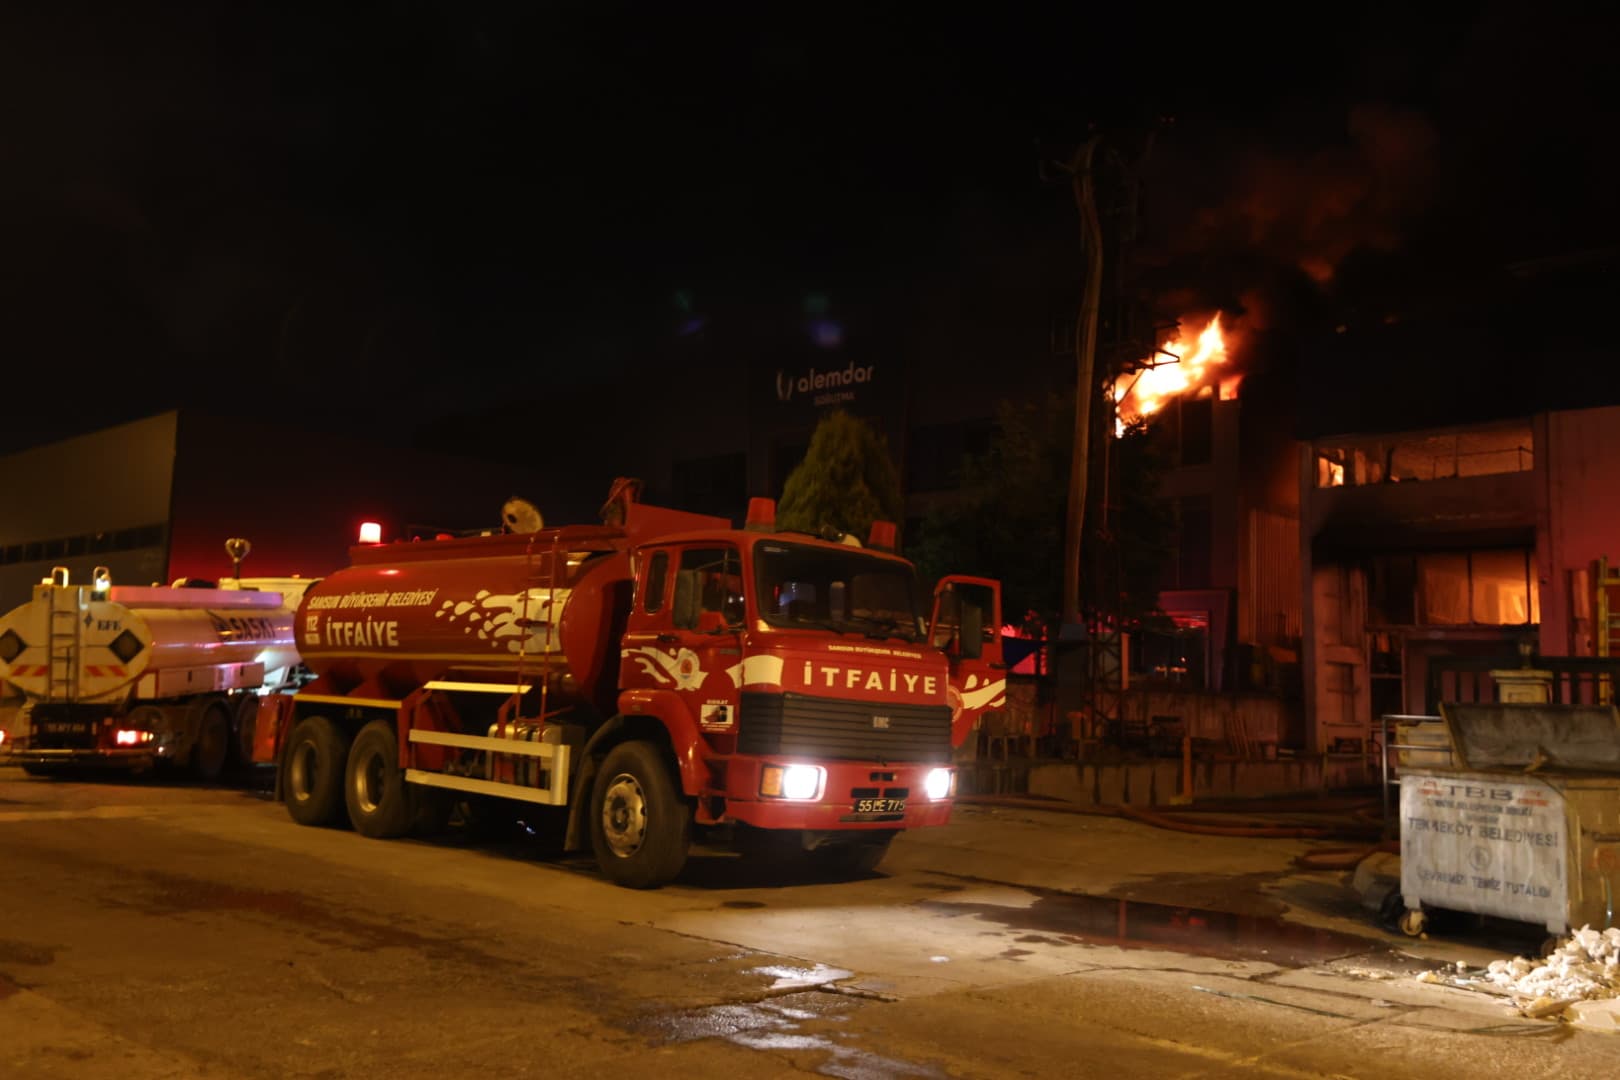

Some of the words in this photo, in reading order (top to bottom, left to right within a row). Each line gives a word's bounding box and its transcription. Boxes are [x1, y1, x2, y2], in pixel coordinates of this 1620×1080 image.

[798, 360, 874, 392] alemdar
[307, 595, 341, 609] SAMSUN
[387, 587, 439, 606] BELEDİYESİ
[326, 615, 399, 647] İTFAİYE
[803, 660, 938, 695] İTFAİYE
[858, 800, 873, 812] 55
[1444, 785, 1513, 801] TBB
